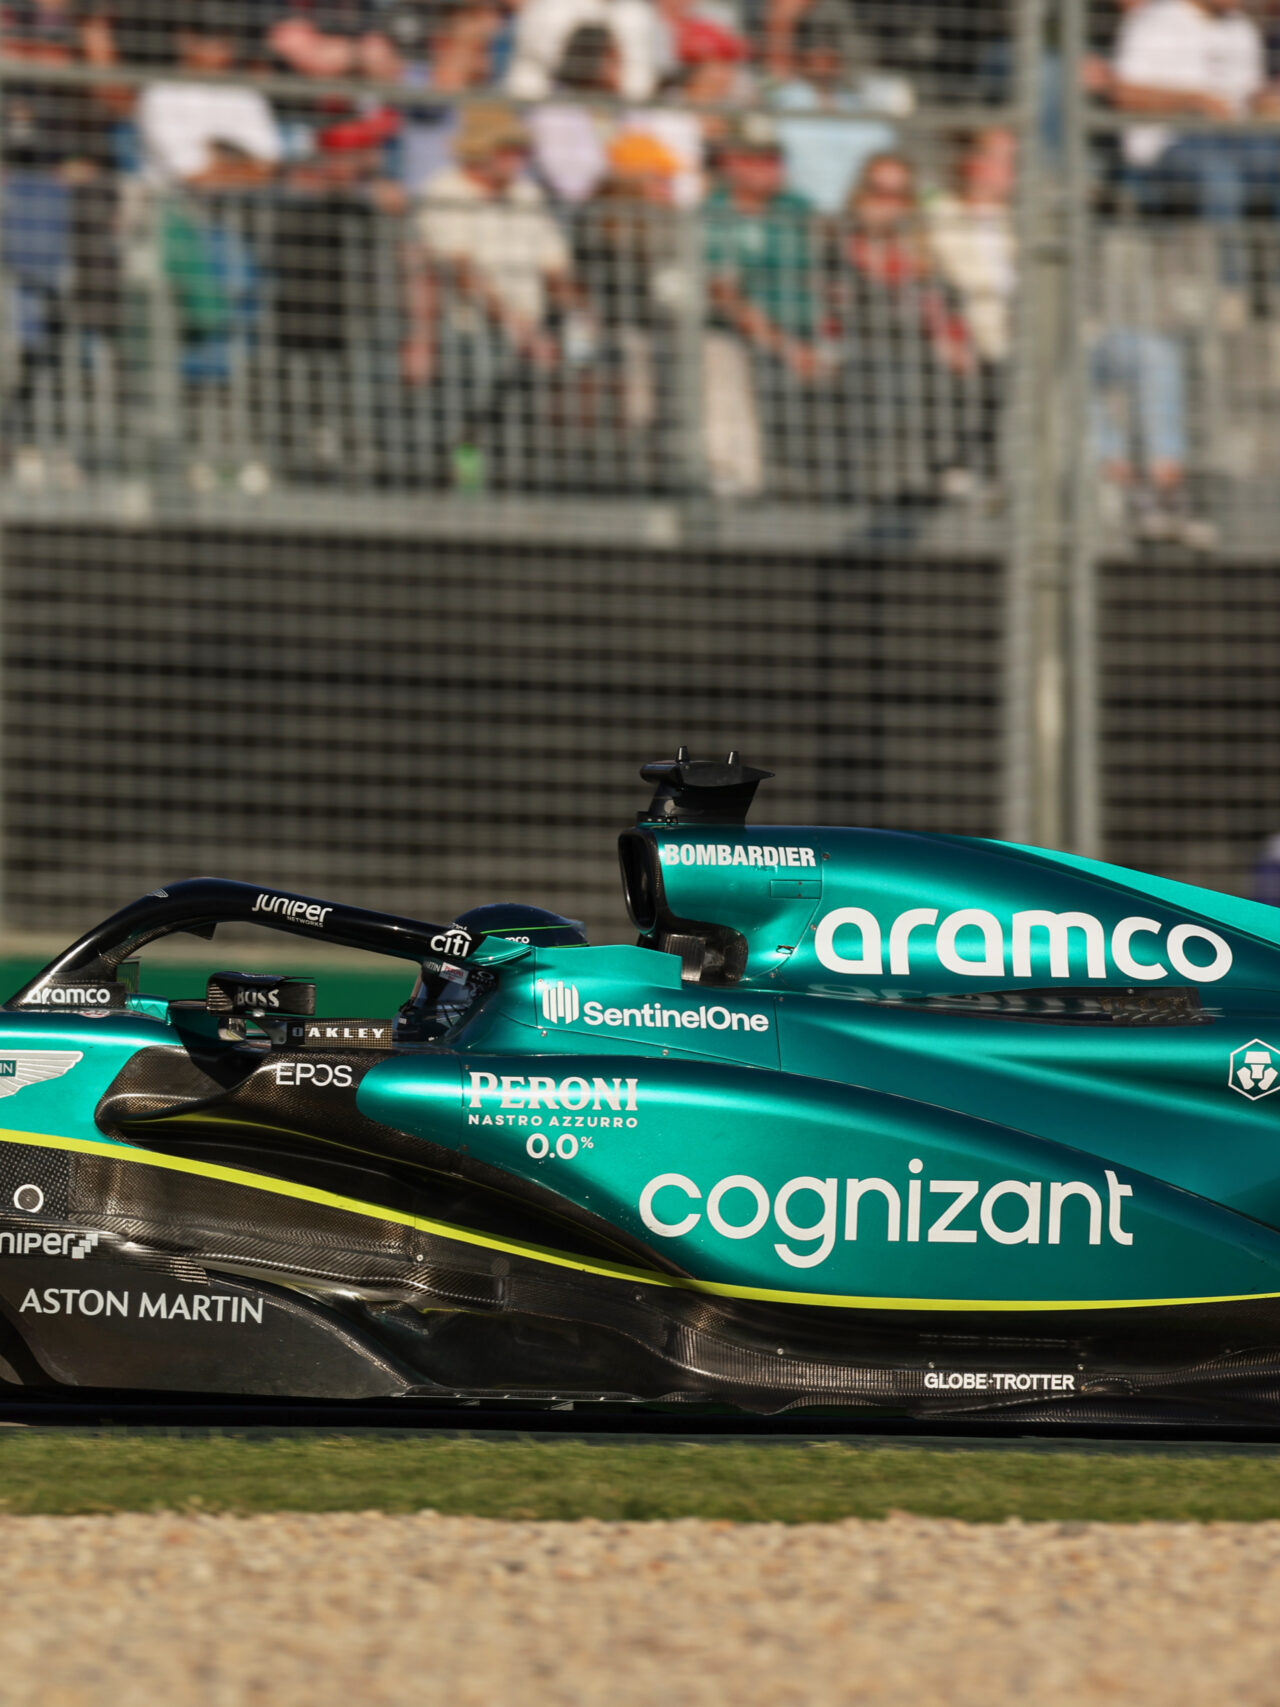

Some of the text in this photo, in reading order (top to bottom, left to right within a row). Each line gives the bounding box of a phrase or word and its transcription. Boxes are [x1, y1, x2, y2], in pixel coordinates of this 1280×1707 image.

[664, 843, 816, 868] BOMBARDIER
[430, 934, 470, 957] citi
[814, 907, 1233, 982] aramco
[22, 987, 111, 1005] aramco
[583, 1001, 770, 1033] SentinelOne
[275, 1062, 353, 1088] EPOS
[468, 1071, 639, 1112] PERONI
[468, 1114, 638, 1129] NASTRO AZZURRO
[638, 1158, 1135, 1269] cognizant
[19, 1288, 264, 1324] ASTON MARTIN
